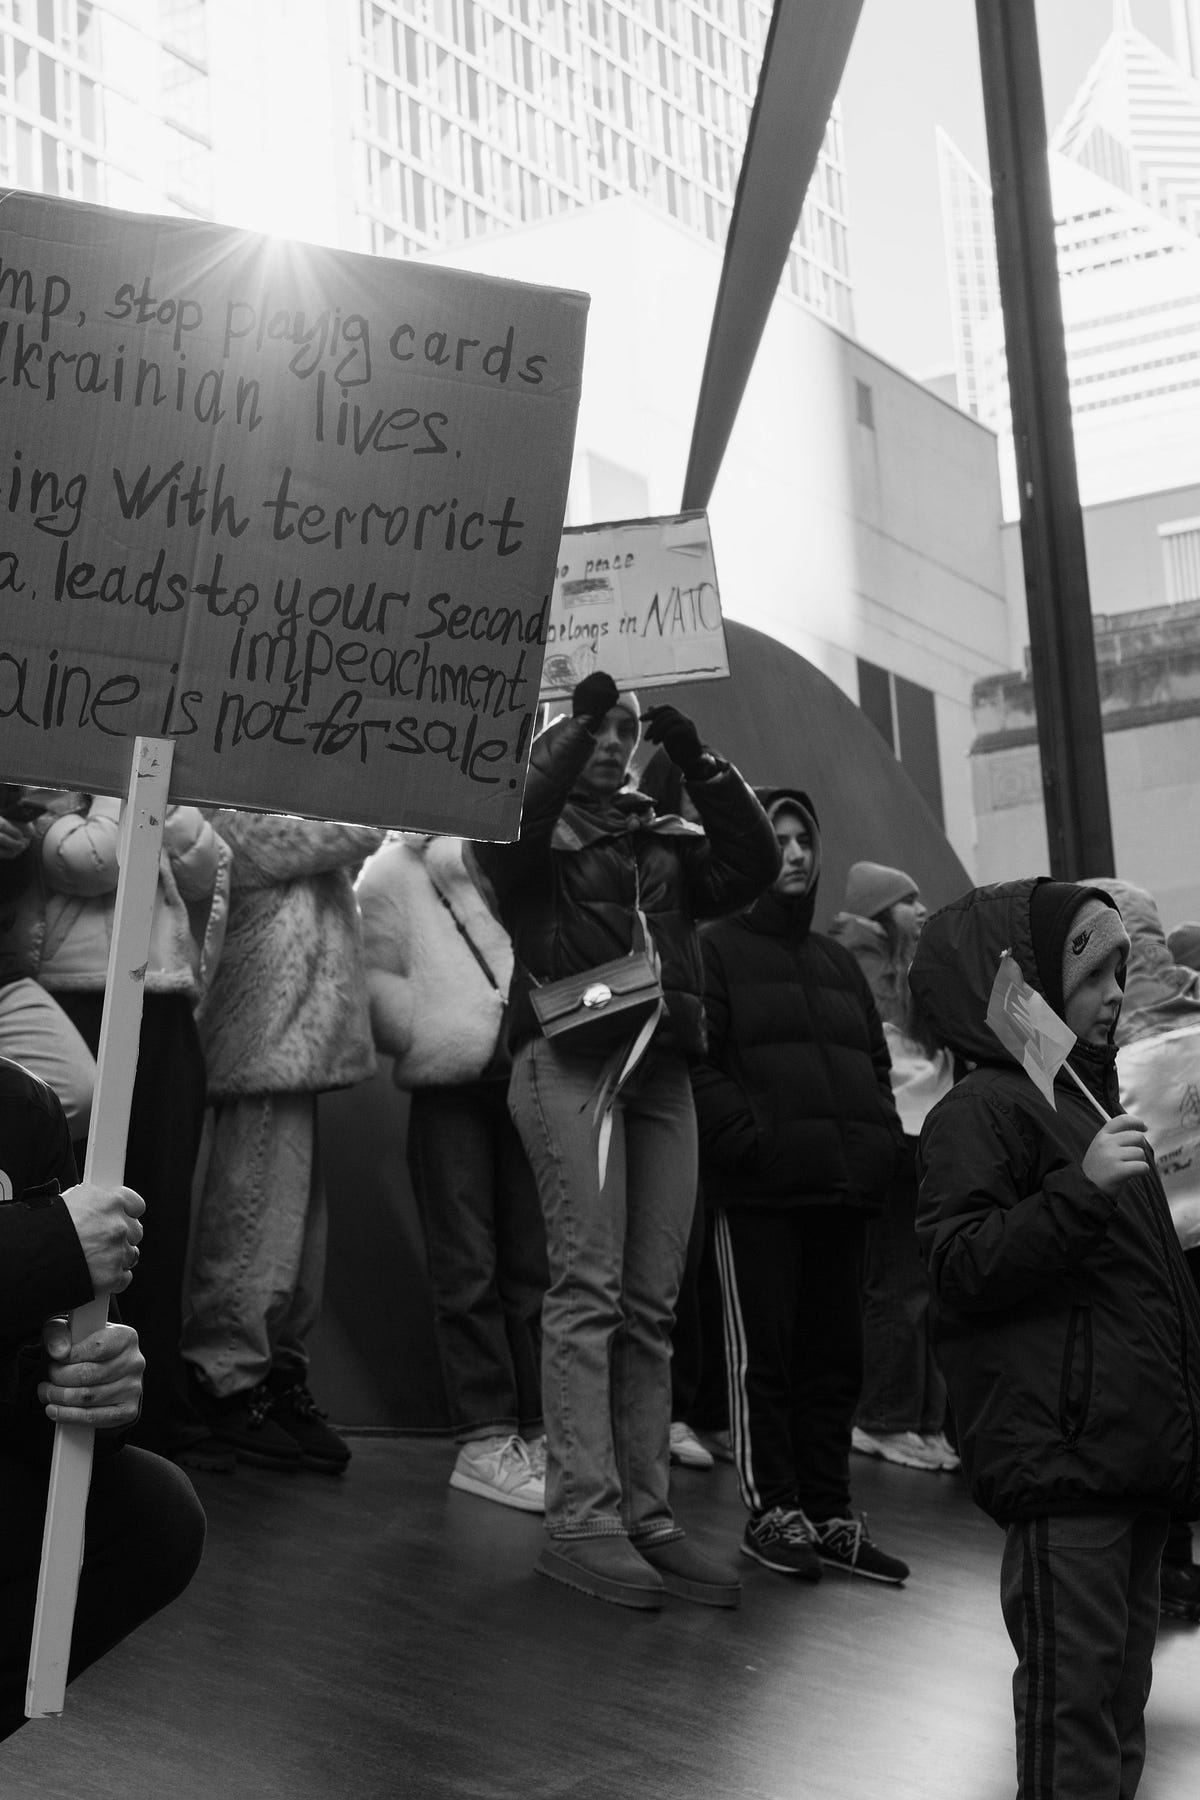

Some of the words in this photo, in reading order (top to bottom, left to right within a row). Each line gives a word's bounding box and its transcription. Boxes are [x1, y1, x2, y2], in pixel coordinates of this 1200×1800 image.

[104, 276, 203, 351] stop
[389, 323, 548, 384] cards
[316, 370, 462, 458] lives.
[263, 467, 524, 556] terrorict
[55, 540, 188, 615] leads
[191, 553, 260, 618] to
[275, 577, 410, 641] your
[416, 592, 551, 646] second
[584, 553, 635, 579] peace
[619, 611, 638, 635] in
[641, 582, 723, 638] NATO
[229, 617, 528, 718] impeachment
[160, 662, 203, 737] is
[213, 684, 307, 754] not
[305, 690, 390, 764] for
[385, 713, 533, 790] sale!
